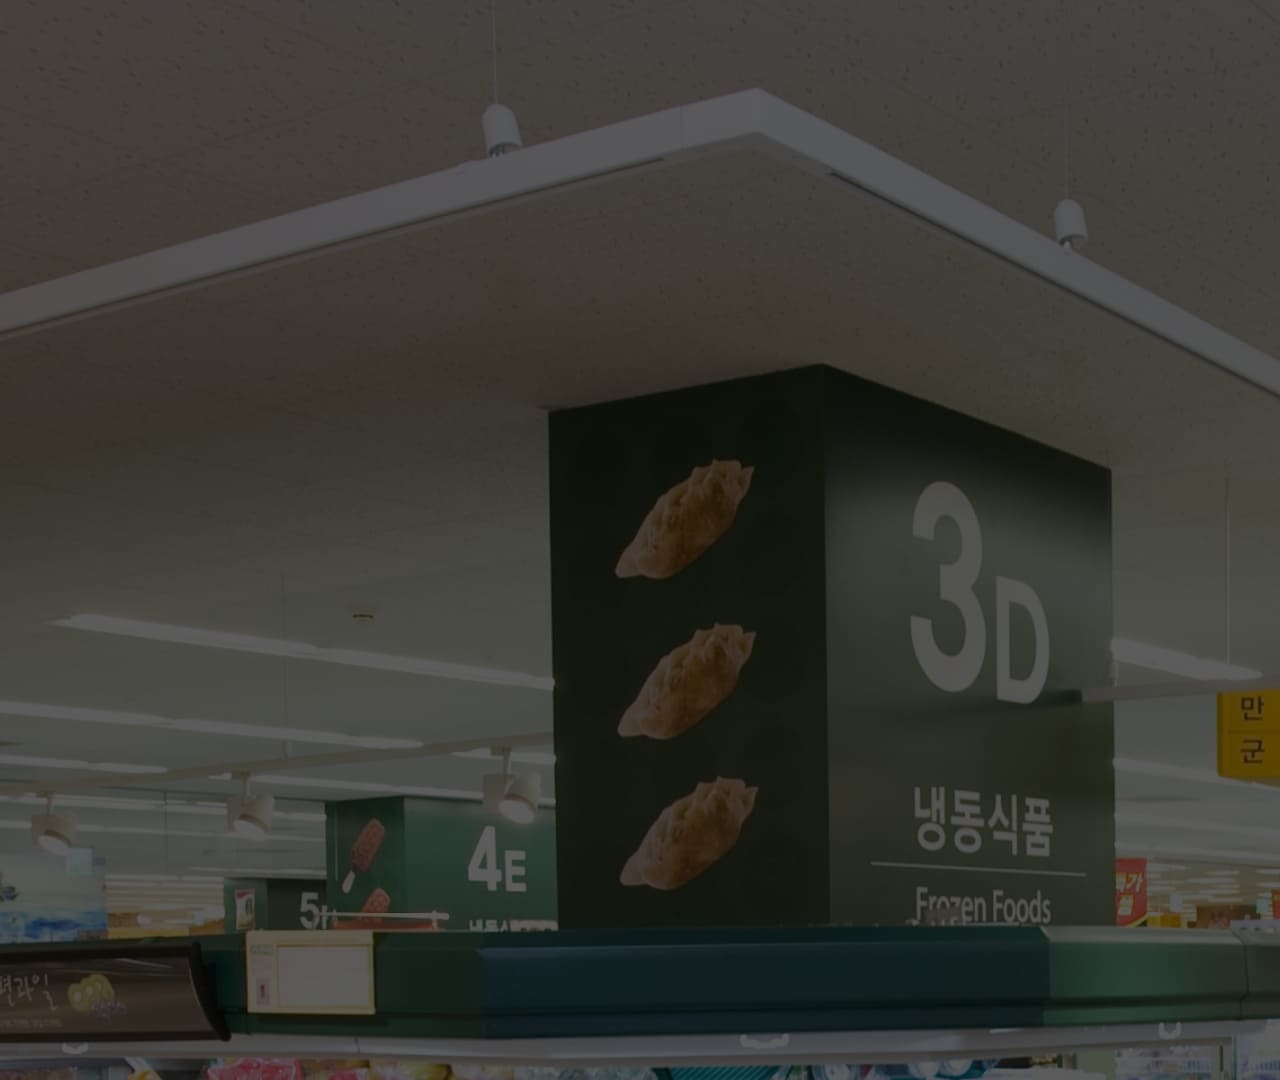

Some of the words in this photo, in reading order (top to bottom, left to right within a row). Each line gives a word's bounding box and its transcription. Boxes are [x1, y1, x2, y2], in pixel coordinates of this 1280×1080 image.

[910, 480, 1051, 705] 3D
[1241, 696, 1264, 721] 만
[1241, 739, 1264, 764] 군
[913, 786, 1054, 858] 냉동식품
[467, 825, 528, 892] 4E
[993, 889, 1052, 924] Foods
